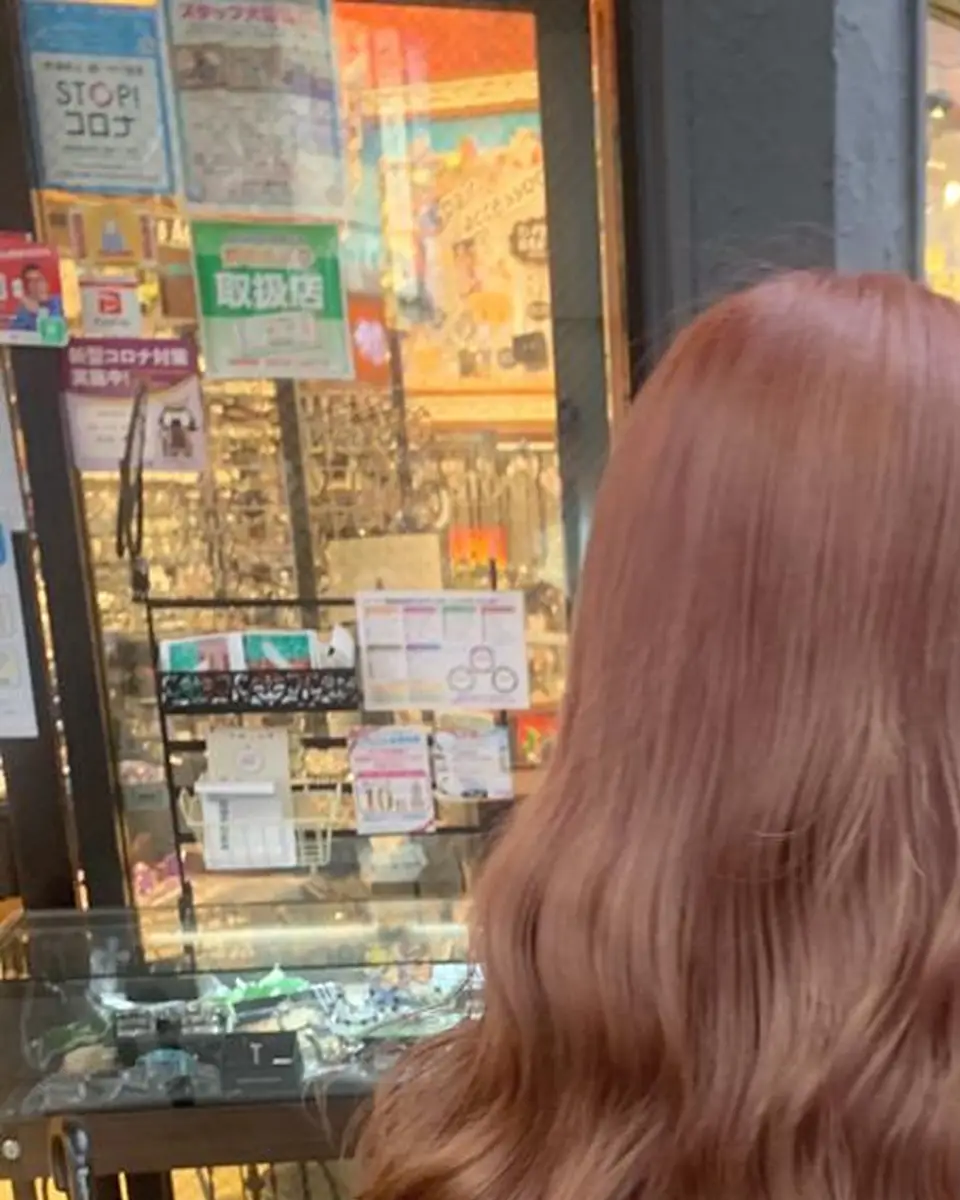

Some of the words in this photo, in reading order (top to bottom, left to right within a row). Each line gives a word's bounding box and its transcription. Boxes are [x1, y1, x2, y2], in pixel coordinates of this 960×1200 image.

[56, 81, 139, 108] STOP!
[65, 111, 135, 137] コロナ
[215, 272, 324, 309] 取扱店
